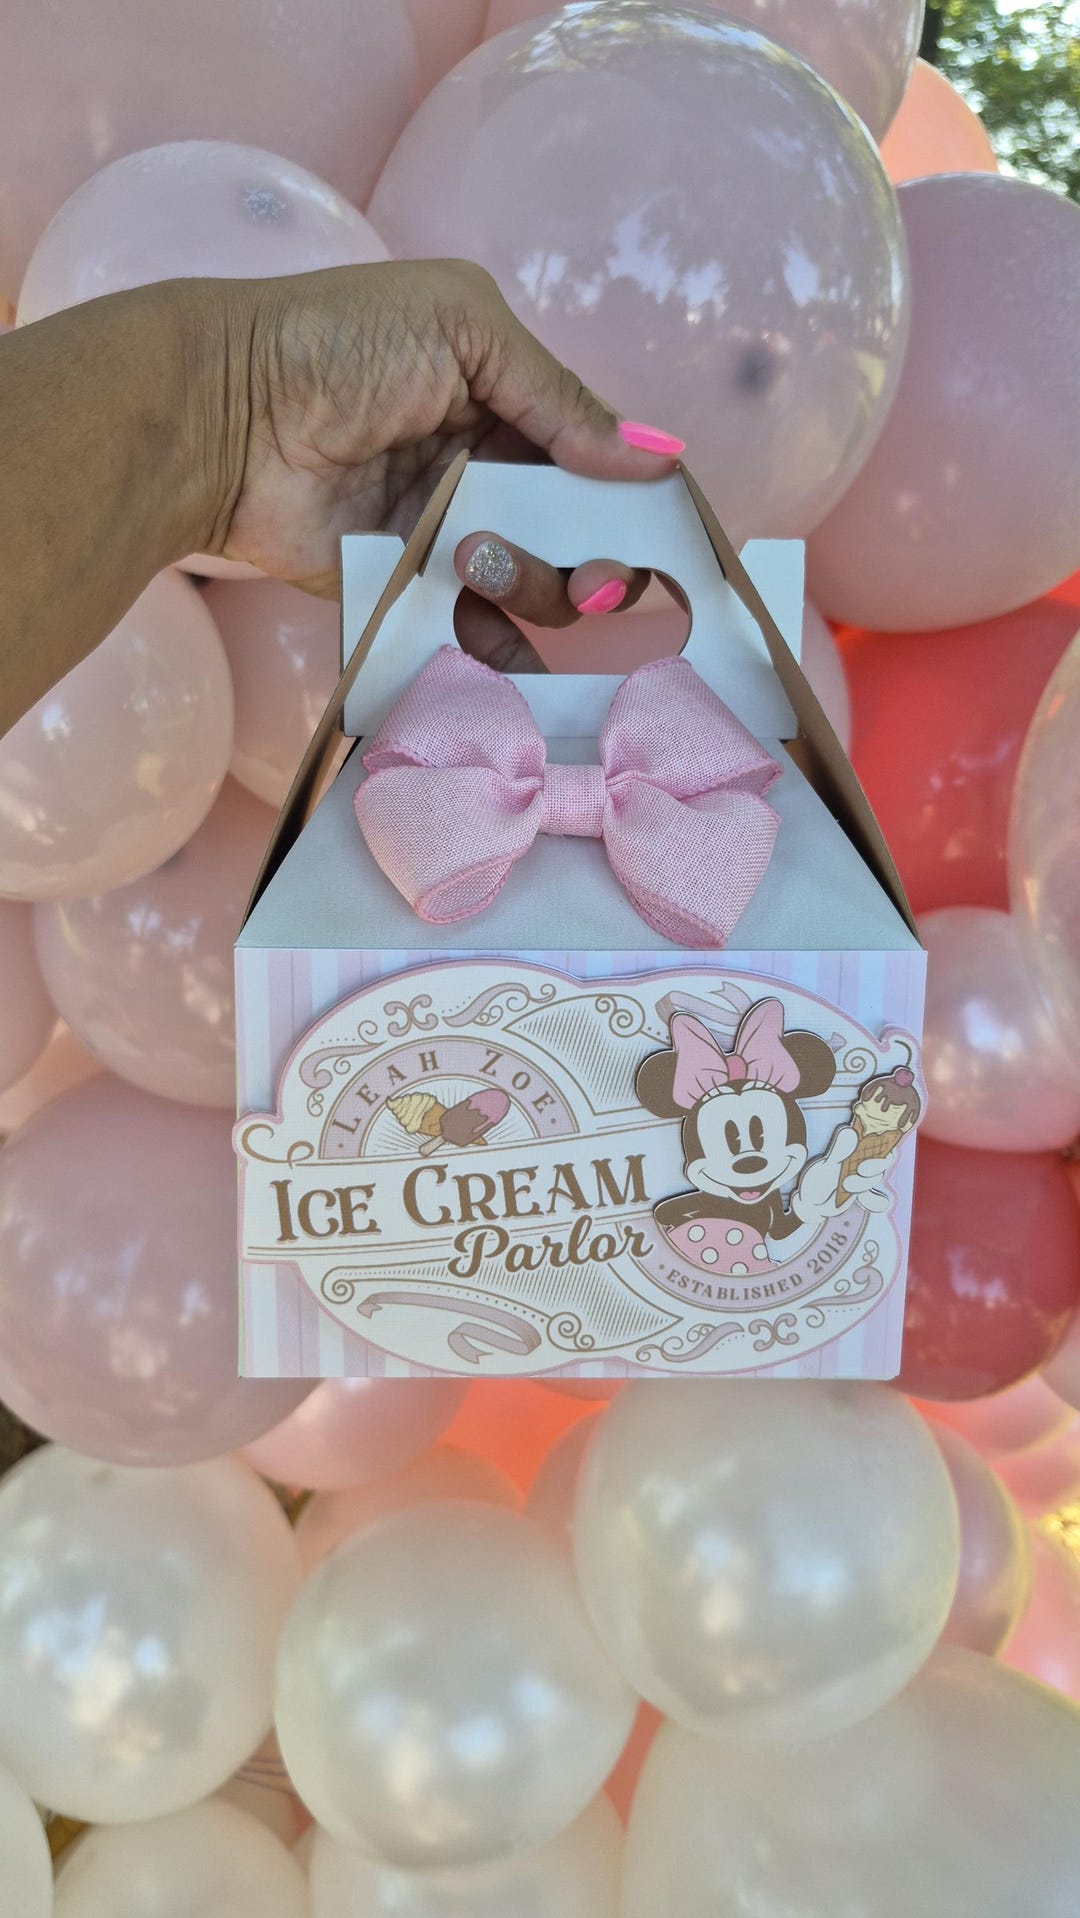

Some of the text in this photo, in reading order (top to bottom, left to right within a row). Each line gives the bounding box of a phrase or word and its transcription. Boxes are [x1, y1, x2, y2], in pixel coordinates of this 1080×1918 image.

[333, 1049, 557, 1135] LEAH ZOE
[271, 1153, 651, 1243] ICE CREAM
[449, 1215, 653, 1278] Parlor
[667, 1231, 848, 1301] ESTABLISHED 2018
